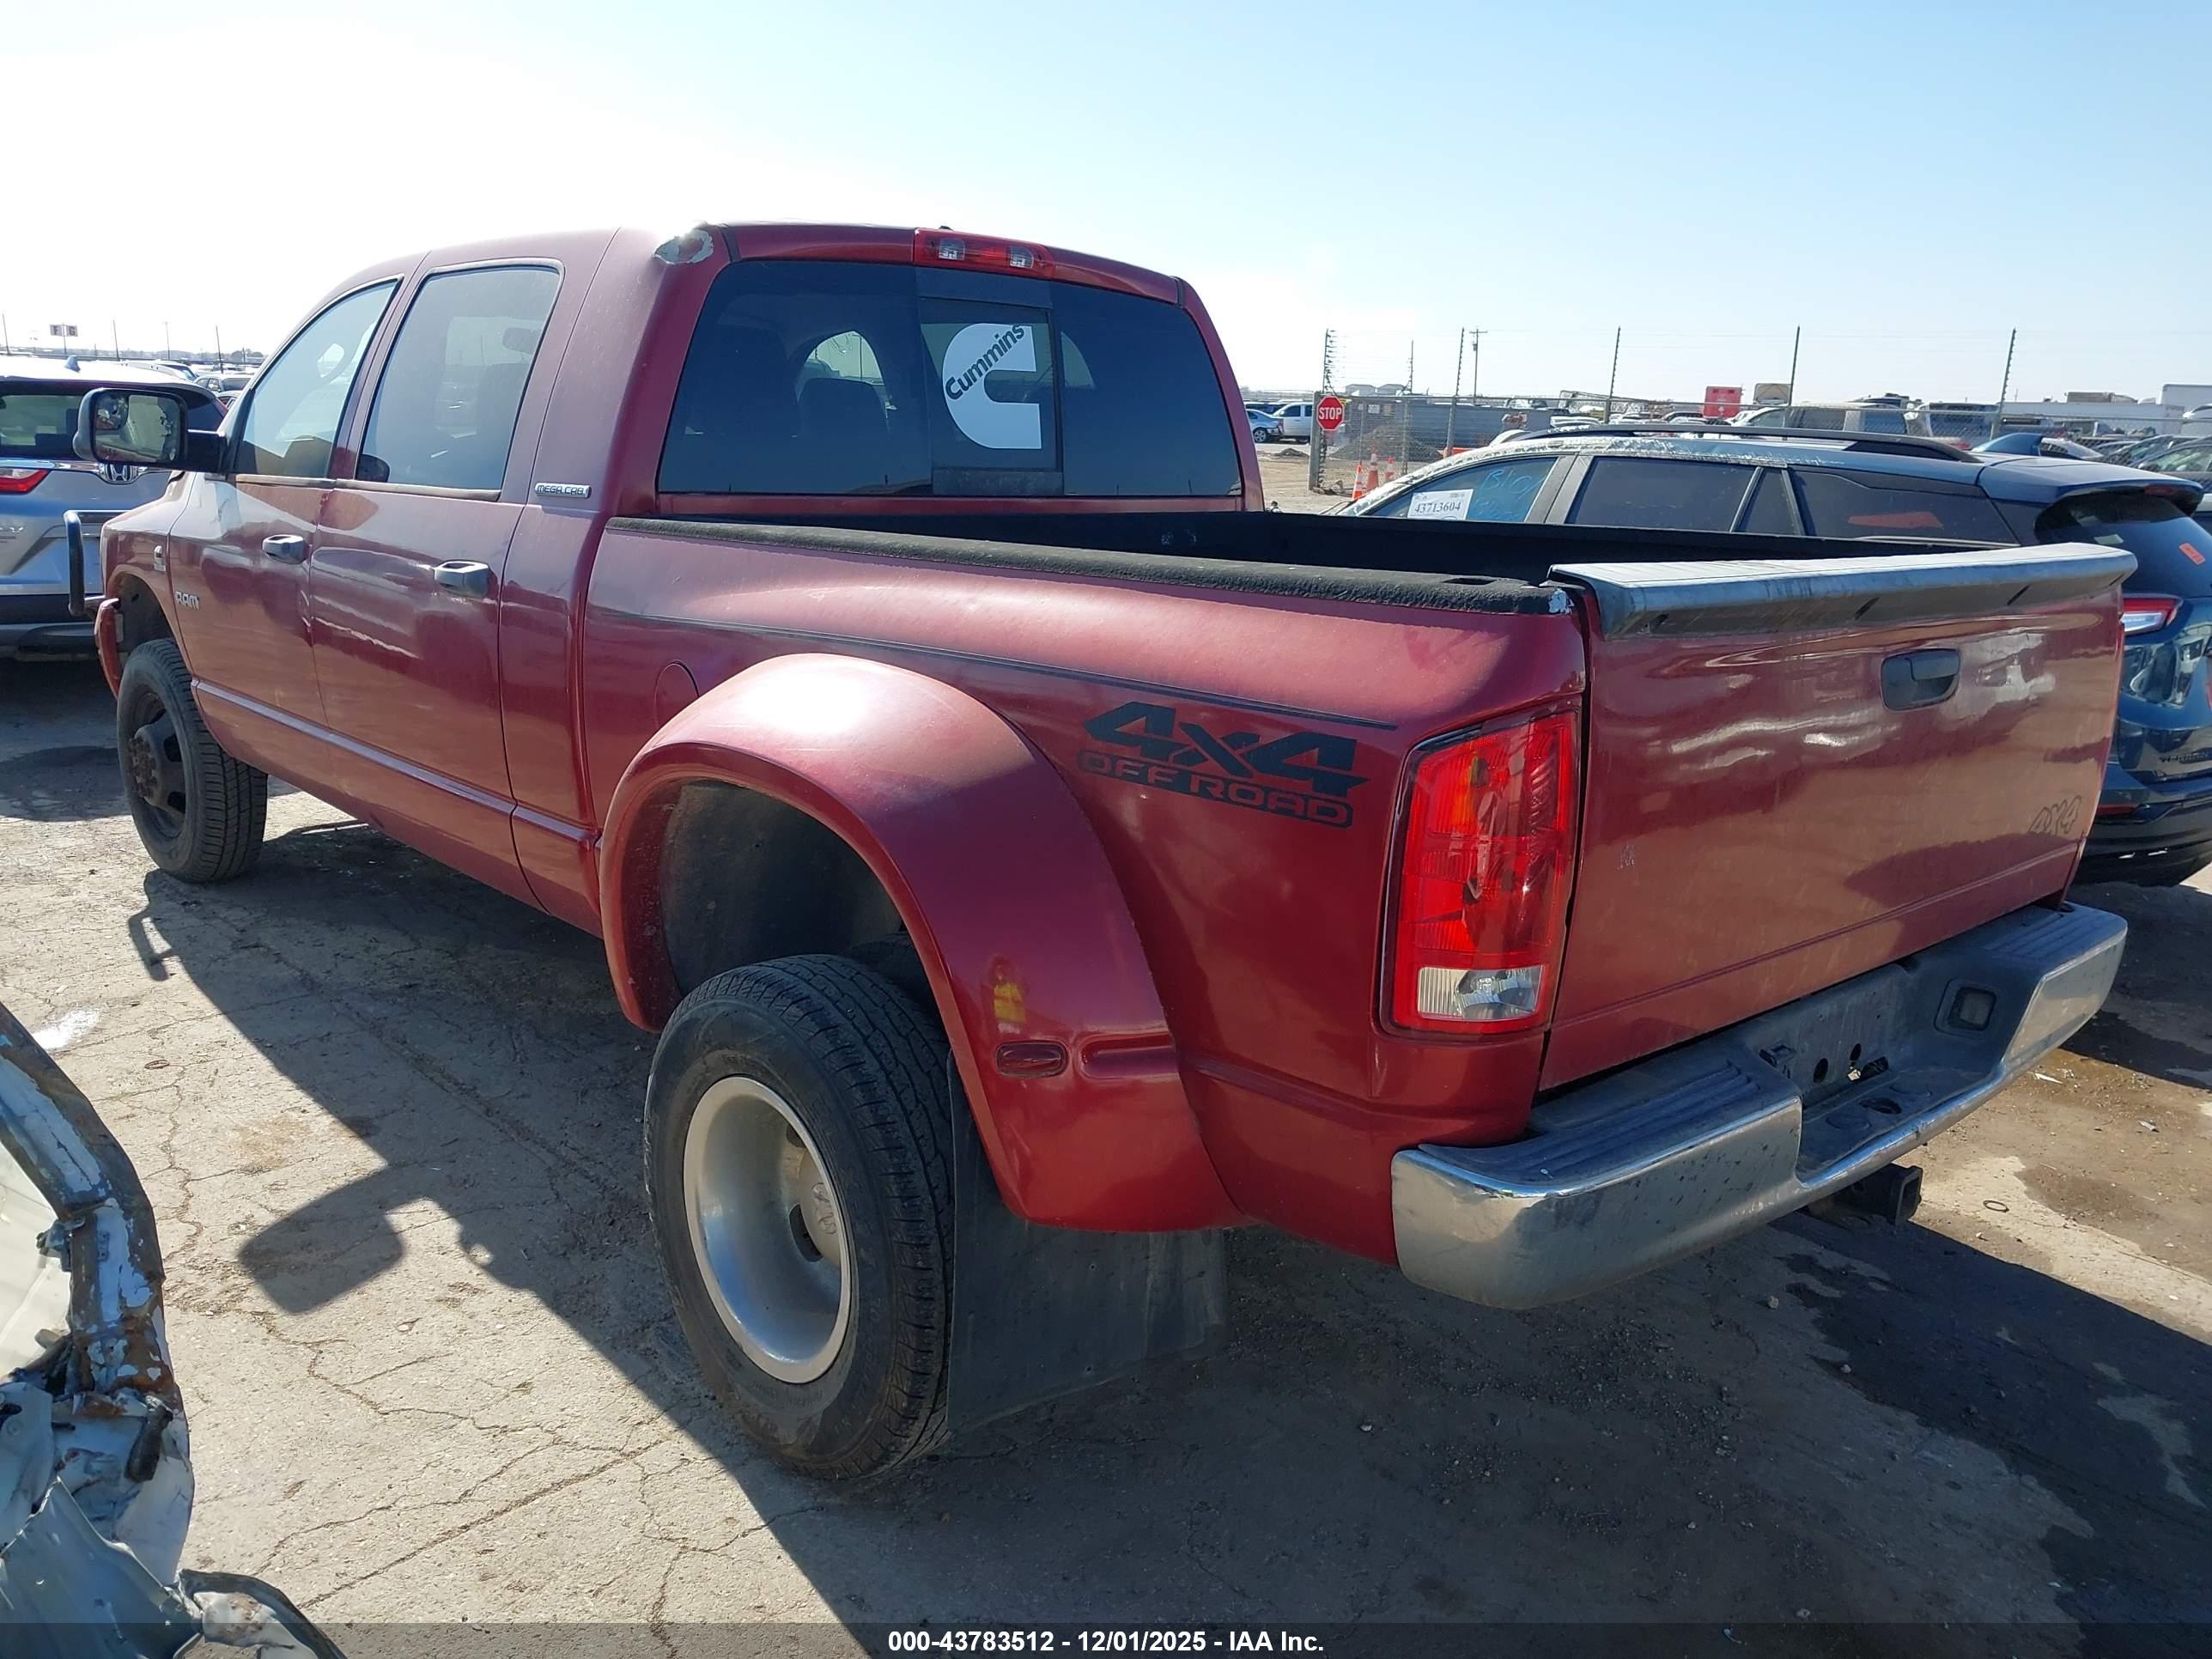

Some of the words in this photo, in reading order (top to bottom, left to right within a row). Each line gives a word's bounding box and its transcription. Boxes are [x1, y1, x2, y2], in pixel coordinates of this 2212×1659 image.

[945, 324, 1025, 400] Cummins
[1318, 407, 1342, 420] STOP
[537, 484, 563, 495] MEGA
[564, 486, 585, 495] CAB
[1414, 500, 1462, 514] 43713604
[174, 590, 201, 611] RAM
[1081, 753, 1181, 786] OFF
[1189, 775, 1352, 826] ROAD
